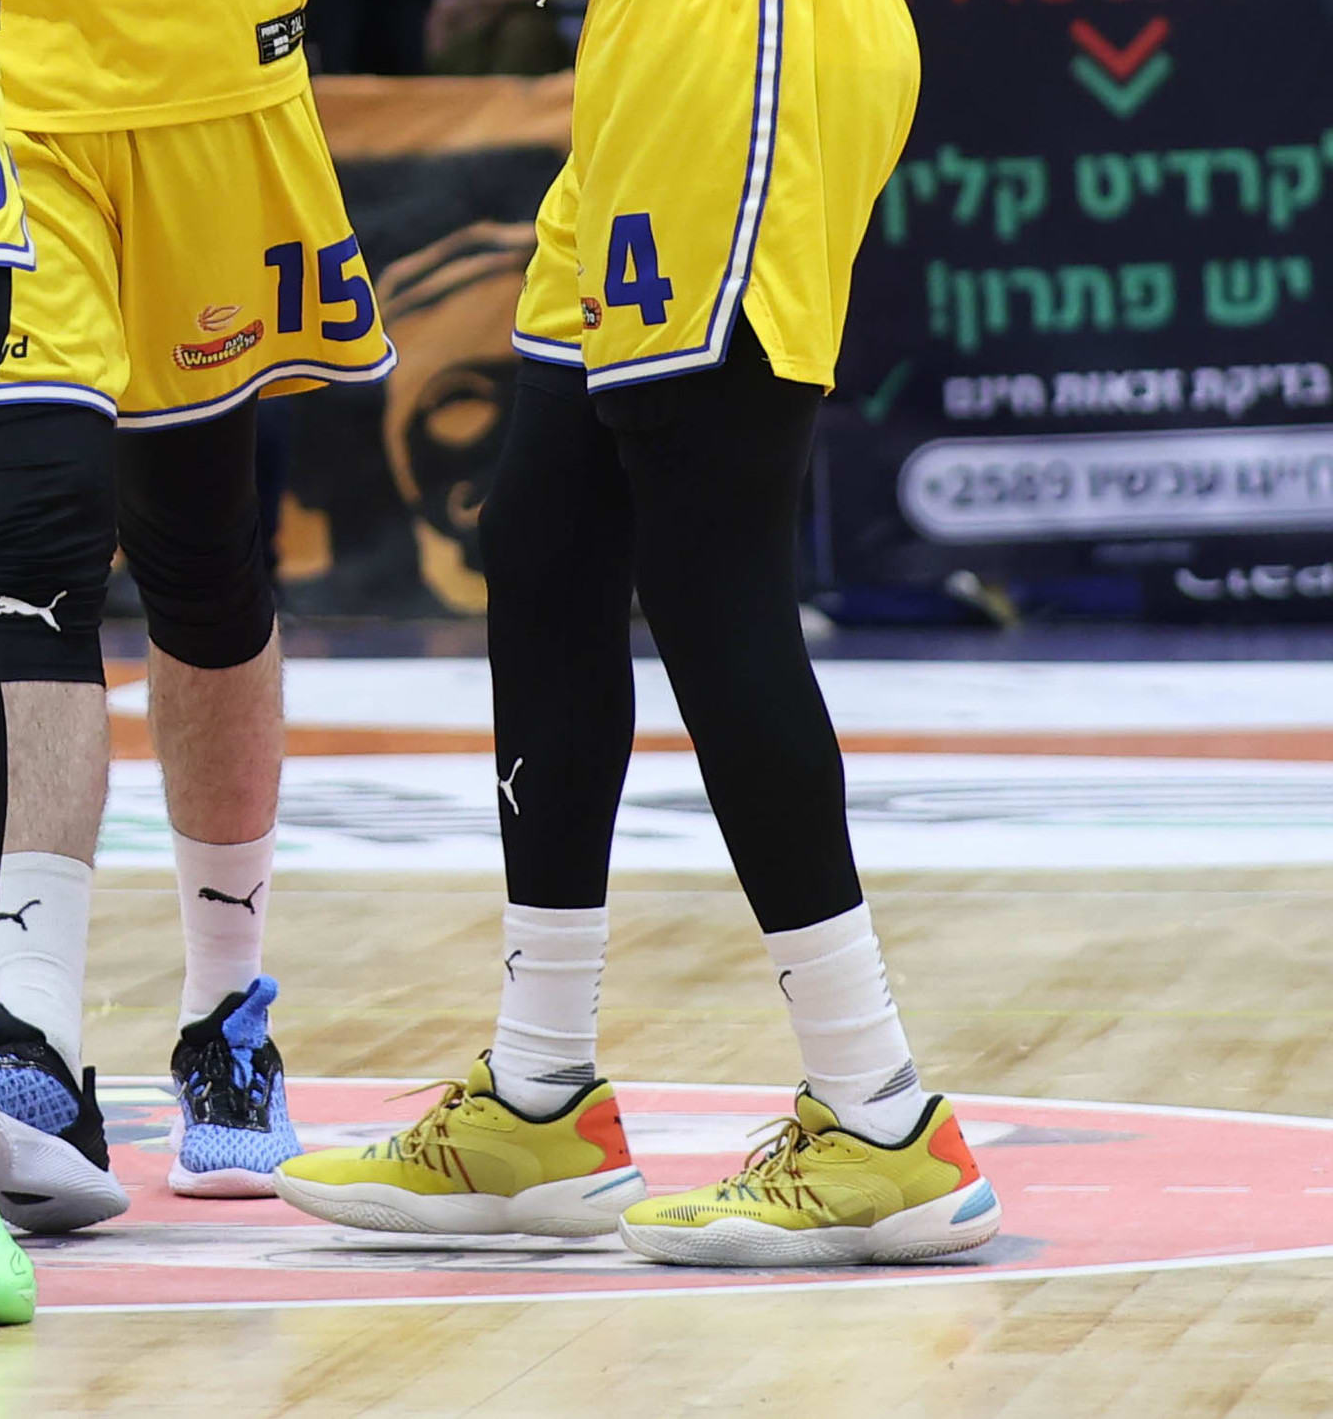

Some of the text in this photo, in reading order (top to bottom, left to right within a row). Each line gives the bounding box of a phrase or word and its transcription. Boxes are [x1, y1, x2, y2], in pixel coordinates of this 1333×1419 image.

[264, 233, 375, 342] 15
[604, 213, 674, 325] 4
[1201, 255, 1314, 328] יש
[183, 339, 245, 366] Winner
